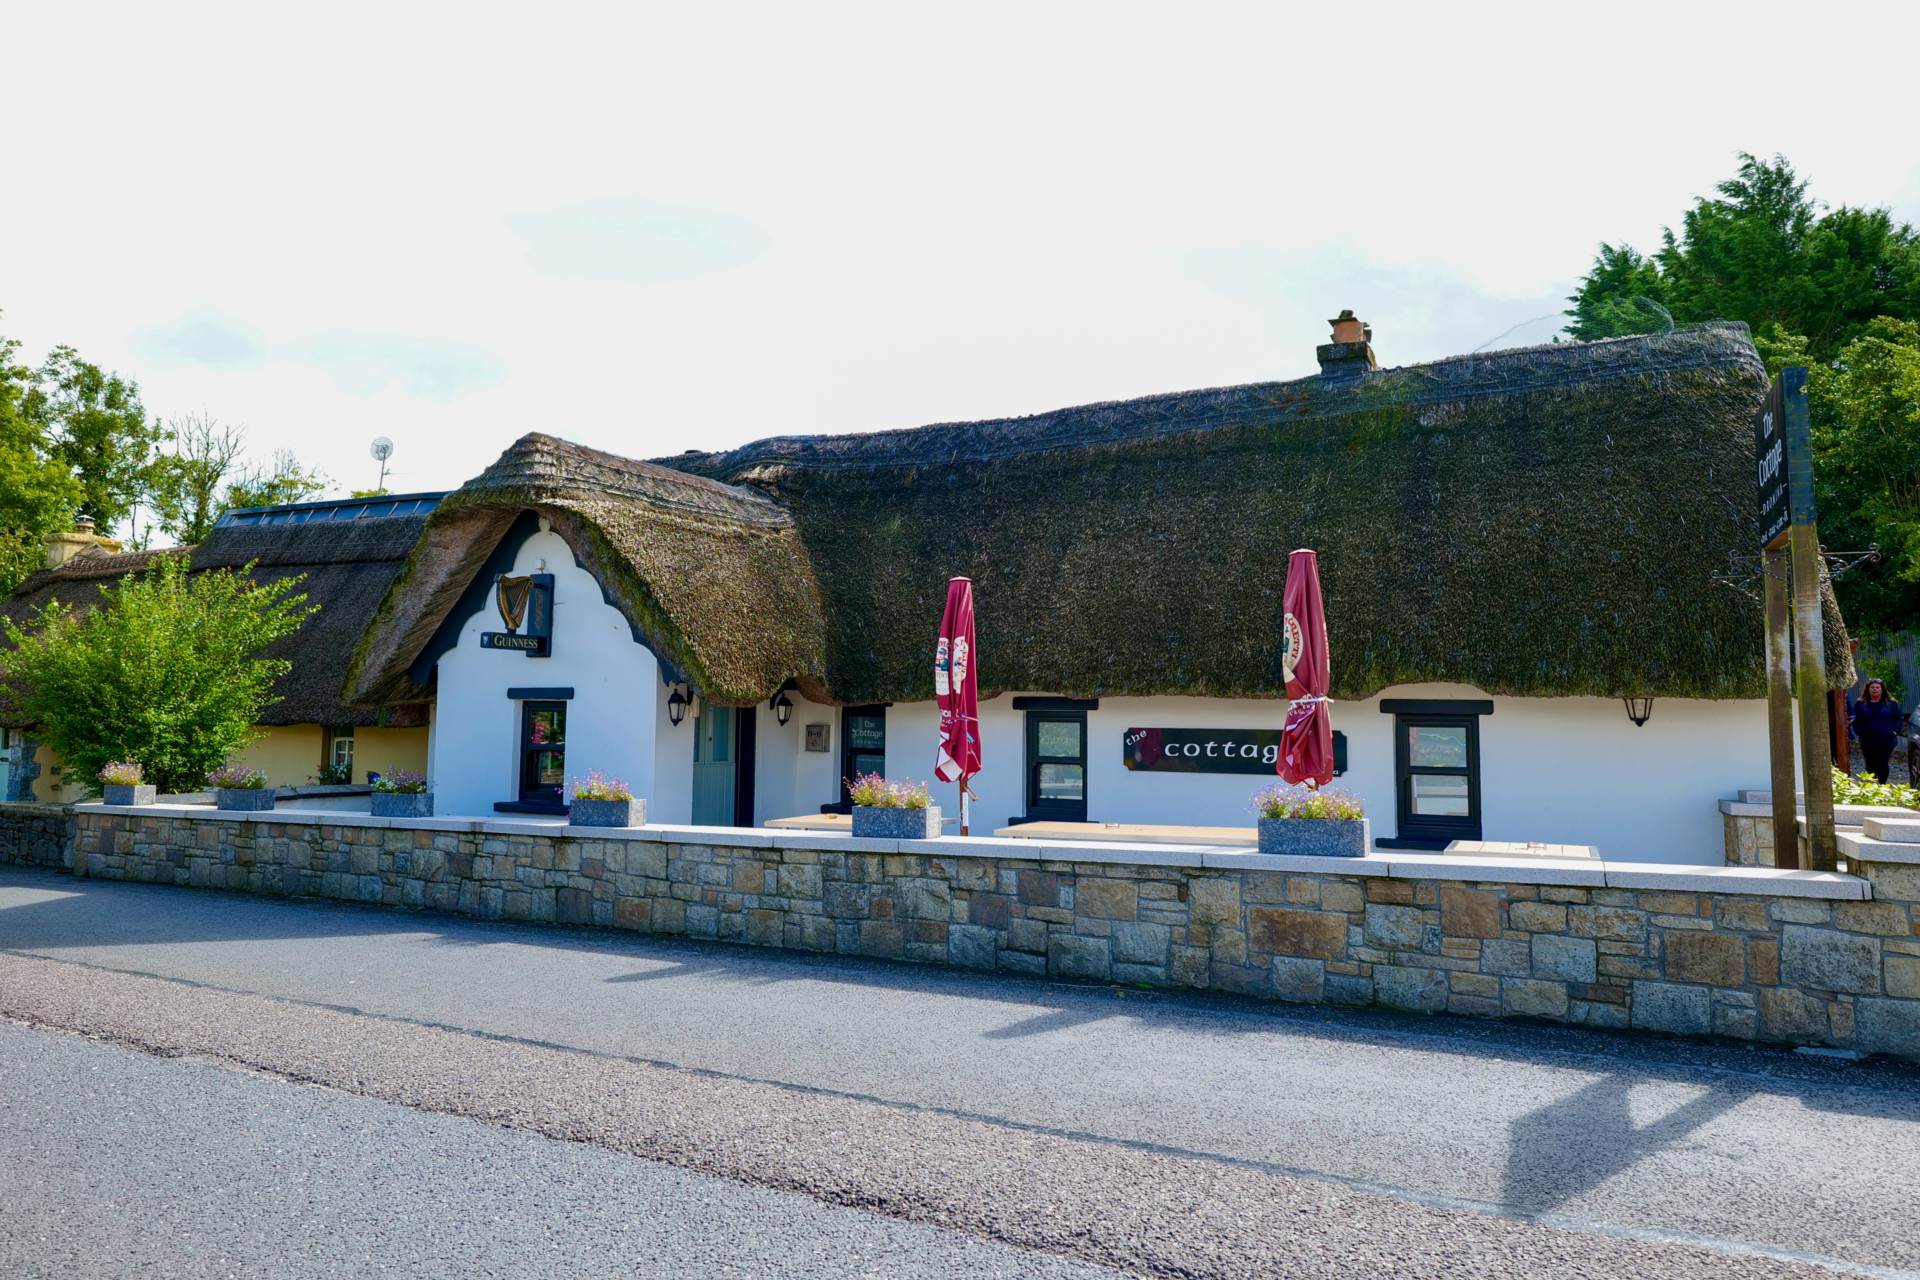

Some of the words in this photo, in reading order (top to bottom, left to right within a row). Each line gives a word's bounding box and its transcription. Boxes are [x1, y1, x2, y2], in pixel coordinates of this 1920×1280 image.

[1758, 438, 1783, 487] Cottage
[494, 635, 538, 649] GUINNESS
[1126, 729, 1148, 746] the
[1164, 741, 1278, 764] cottag
